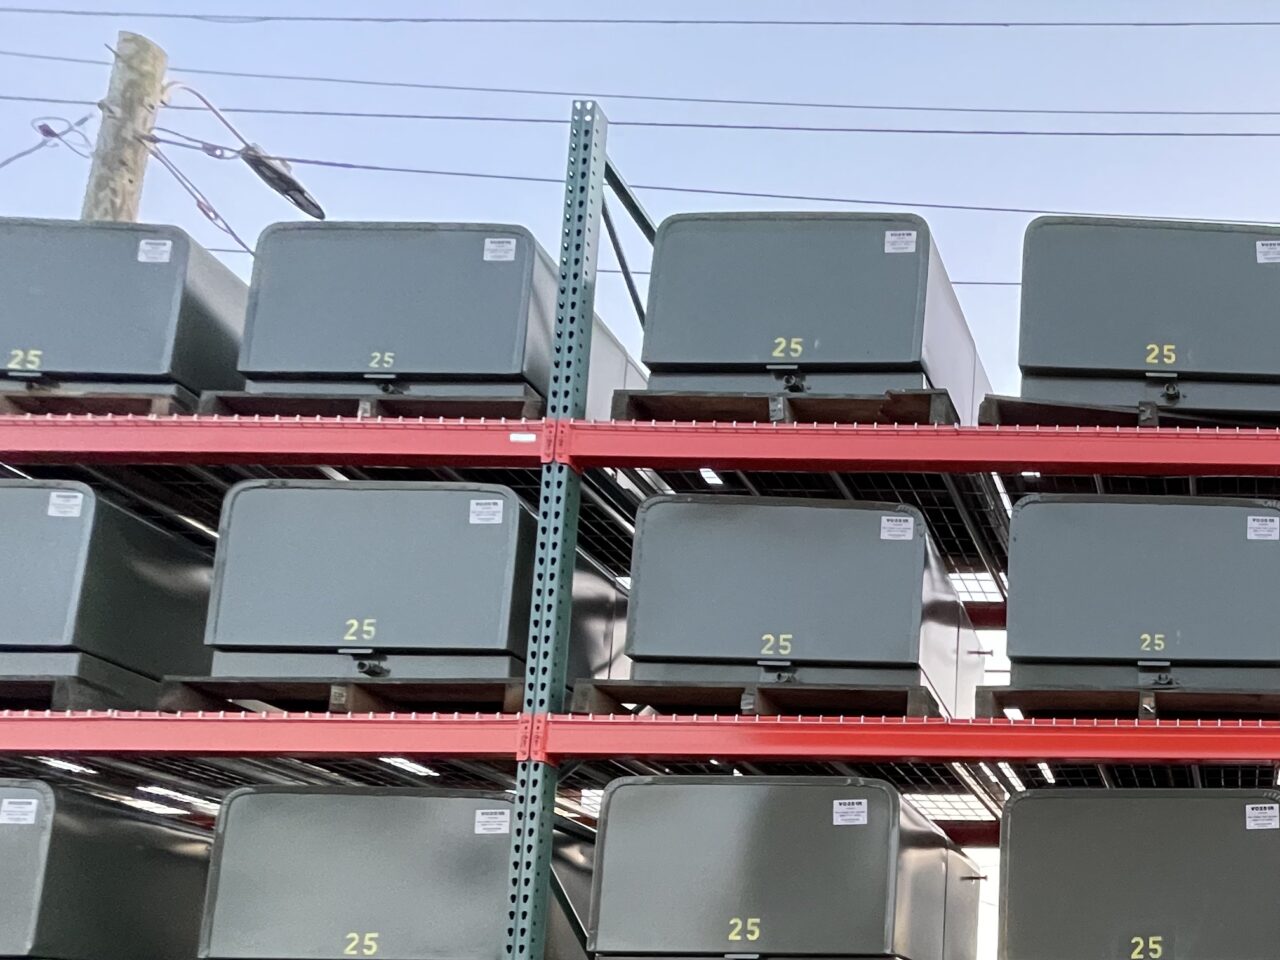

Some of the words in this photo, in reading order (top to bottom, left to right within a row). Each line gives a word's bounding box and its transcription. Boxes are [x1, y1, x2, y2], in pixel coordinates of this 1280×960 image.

[7, 349, 43, 368] 25
[369, 352, 394, 368] 25
[772, 337, 803, 360] 25
[1146, 343, 1176, 364] 25
[344, 618, 375, 641] 25
[762, 633, 792, 656] 25
[1140, 633, 1169, 652] 25
[728, 917, 760, 942] 25
[344, 932, 378, 956] 25
[1131, 936, 1162, 960] 25
